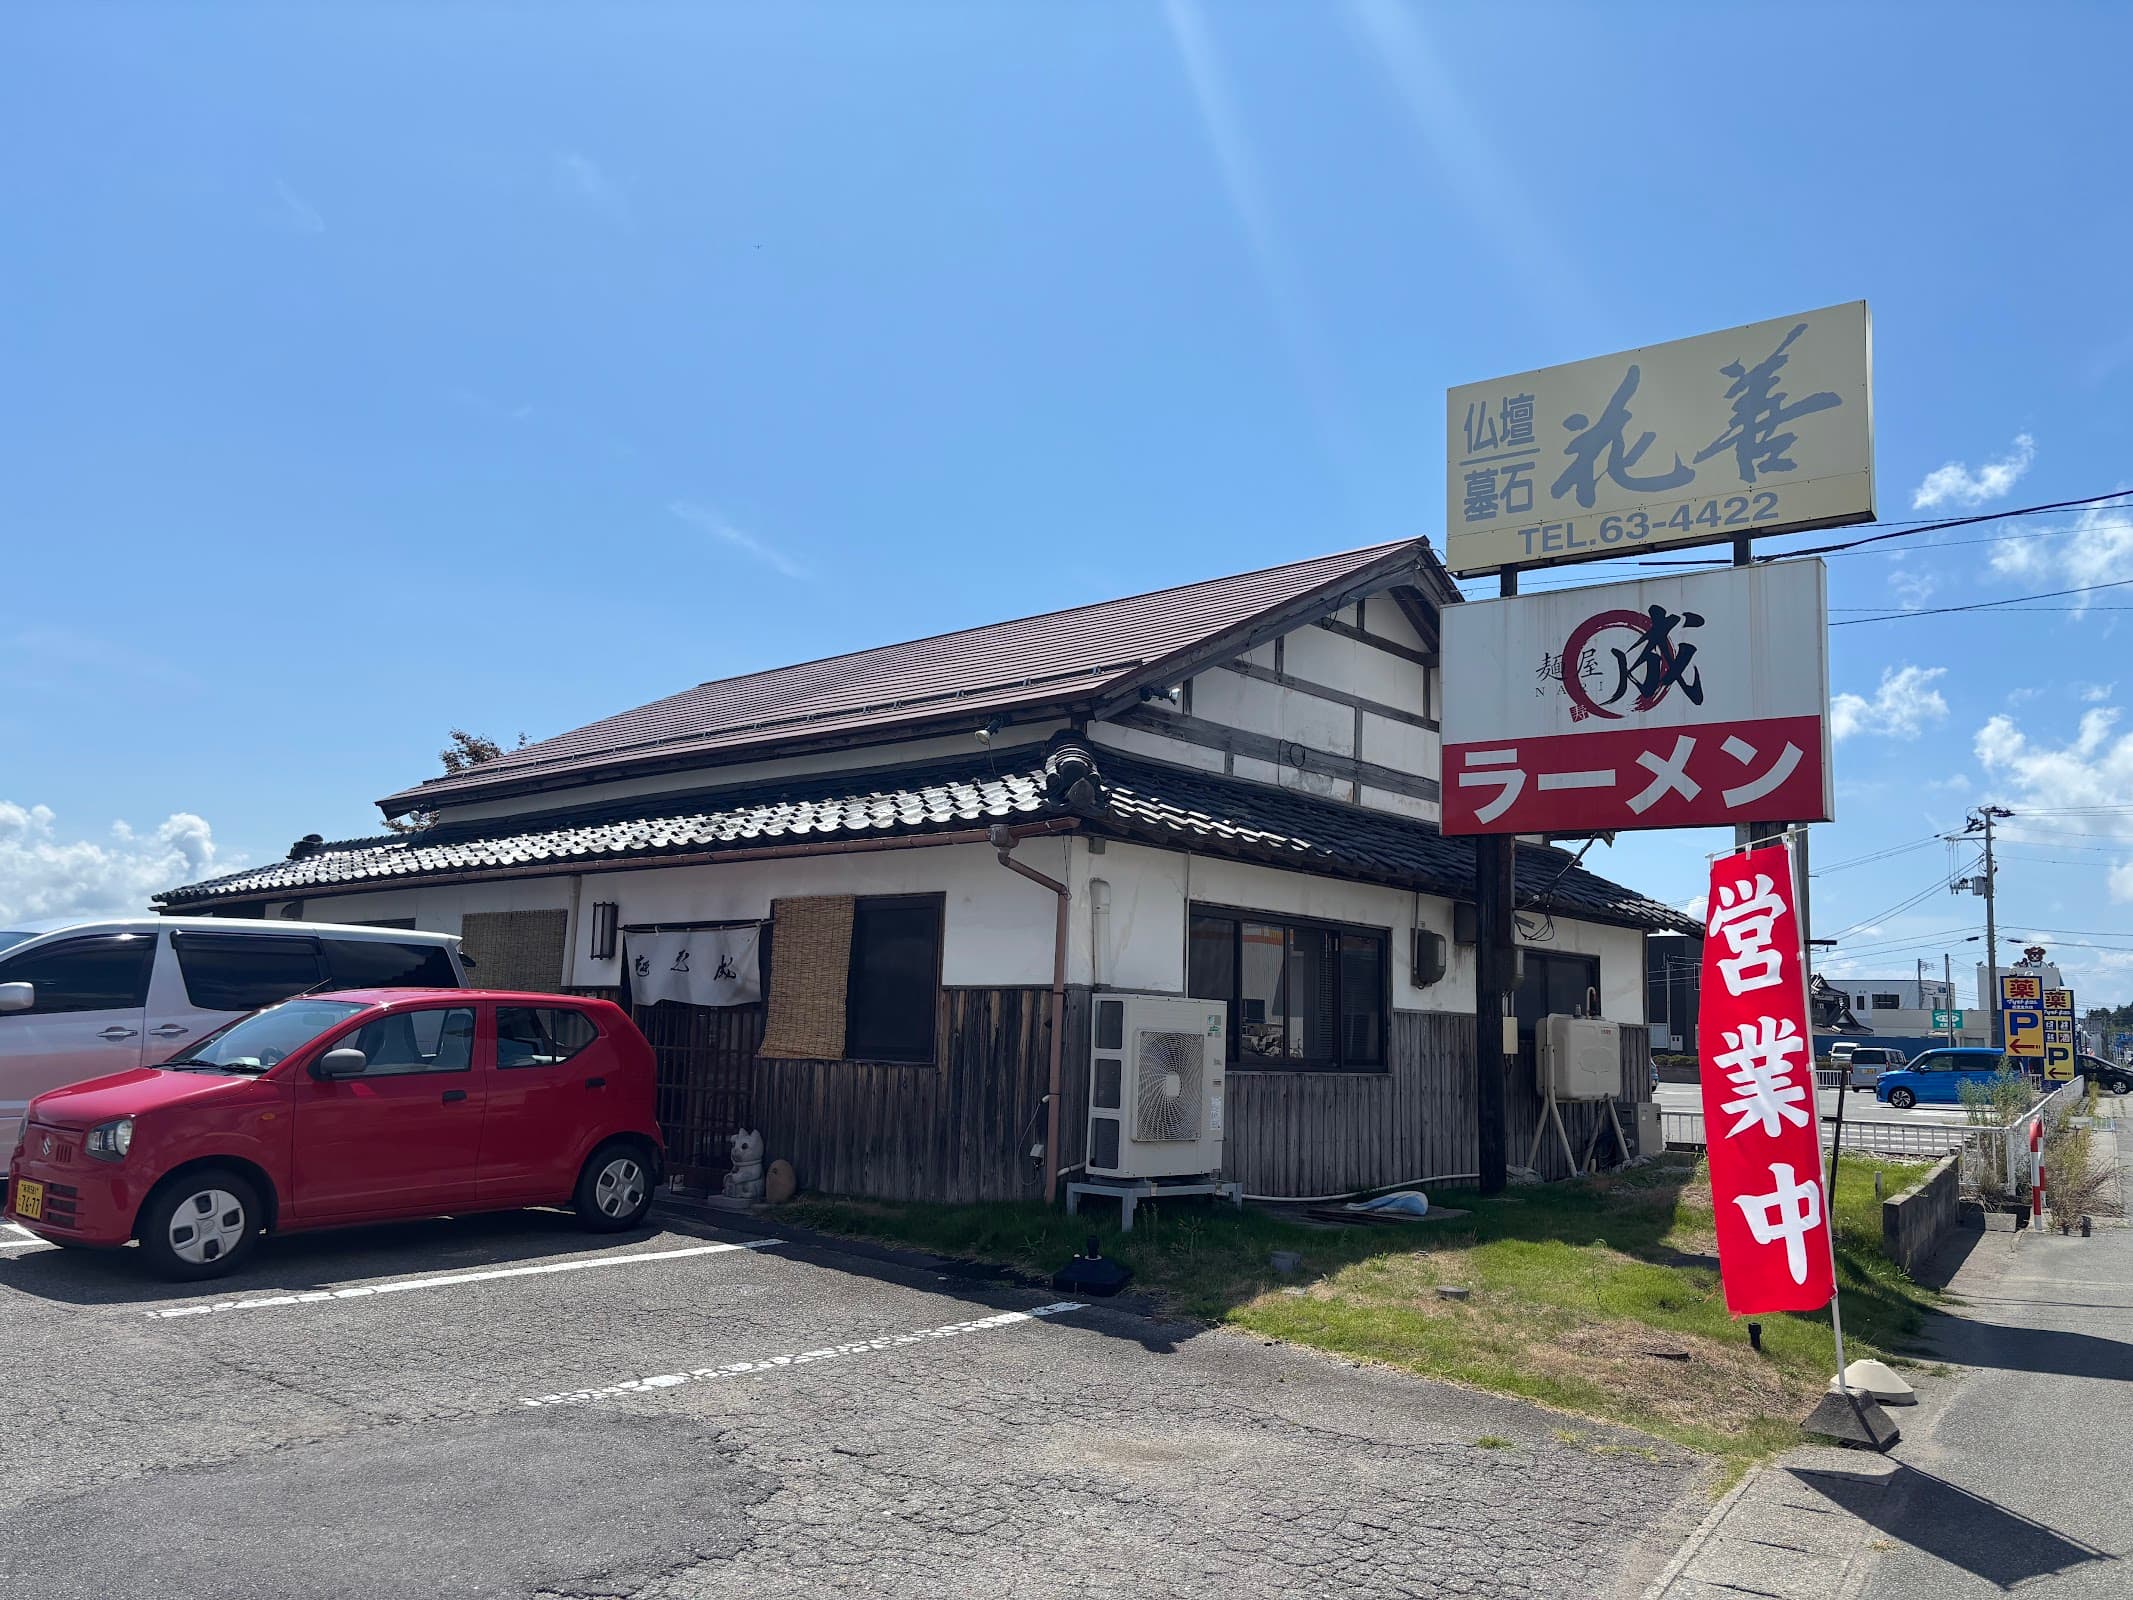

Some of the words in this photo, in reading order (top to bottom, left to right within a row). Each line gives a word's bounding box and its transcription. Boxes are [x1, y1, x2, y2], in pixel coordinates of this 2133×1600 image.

[1463, 392, 1536, 454] 仏壇
[1463, 461, 1536, 522] 墓石
[1458, 734, 1804, 825] ラーメン
[2009, 979, 2035, 998] 薬
[2044, 991, 2067, 1008] 薬
[2009, 1012, 2039, 1036] P
[2048, 1047, 2069, 1066] P
[1709, 873, 1821, 1286] 営業中
